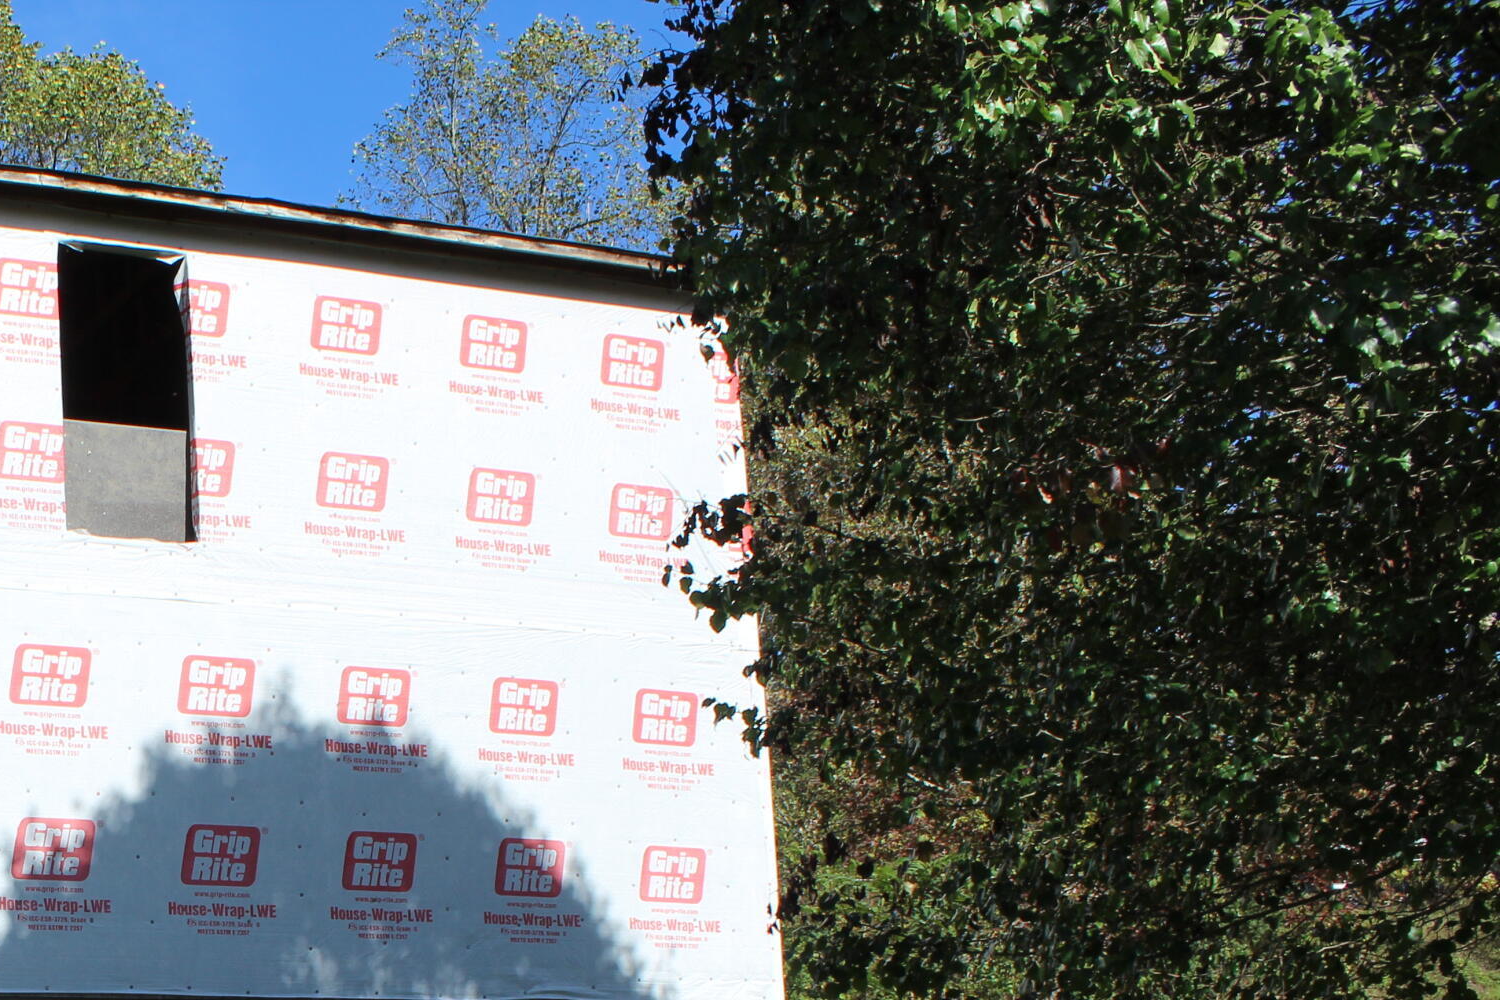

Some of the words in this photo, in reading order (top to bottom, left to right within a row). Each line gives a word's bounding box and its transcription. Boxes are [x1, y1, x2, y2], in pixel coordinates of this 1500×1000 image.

[0, 288, 55, 315] Rite
[320, 300, 374, 330] Grip
[319, 324, 370, 350] Rite
[469, 319, 520, 348] Grip
[468, 342, 516, 368] Rite
[609, 338, 657, 367] Grip
[298, 362, 399, 386] House-Wrap-LWE
[609, 361, 654, 386] Rite
[449, 380, 544, 404] House-Wrap-LWE
[590, 397, 681, 421] House-Wrap-LWE
[4, 425, 64, 456] Grip
[1, 451, 58, 478] Rite
[326, 456, 381, 486] Grip
[325, 481, 376, 507] Rite
[476, 472, 527, 501] Grip
[475, 496, 523, 521] Rite
[617, 487, 666, 516] Grip
[304, 521, 406, 543] House-Wrap-LWE
[617, 511, 663, 536] Rite
[455, 535, 552, 557] House-Wrap-LWE
[21, 649, 82, 680] Grip
[189, 660, 246, 690] Grip
[19, 675, 77, 702] Rite
[347, 671, 402, 700] Grip
[499, 682, 551, 711] Grip
[187, 686, 242, 712] Rite
[346, 696, 398, 722] Rite
[641, 693, 691, 721] Grip
[498, 706, 547, 731] Rite
[641, 717, 687, 742] Rite
[165, 729, 272, 749] House-Wrap-LWE
[325, 738, 428, 758] House-Wrap-LWE
[478, 747, 575, 767] House-Wrap-LWE
[622, 757, 715, 777] House-Wrap-LWE
[24, 822, 85, 853] Grip
[193, 829, 251, 859] Grip
[353, 836, 408, 865] Grip
[22, 850, 80, 876] Rite
[191, 856, 246, 881] Rite
[505, 843, 557, 871] Grip
[648, 850, 698, 878] Grip
[352, 862, 404, 887] Rite
[503, 868, 553, 892] Rite
[648, 875, 695, 899] Rite
[168, 901, 277, 920] House-Wrap-LWE
[330, 906, 433, 924] House-Wrap-LWE
[483, 911, 581, 929] House-Wrap-LWE
[628, 916, 722, 934] House-Wrap-LWE
